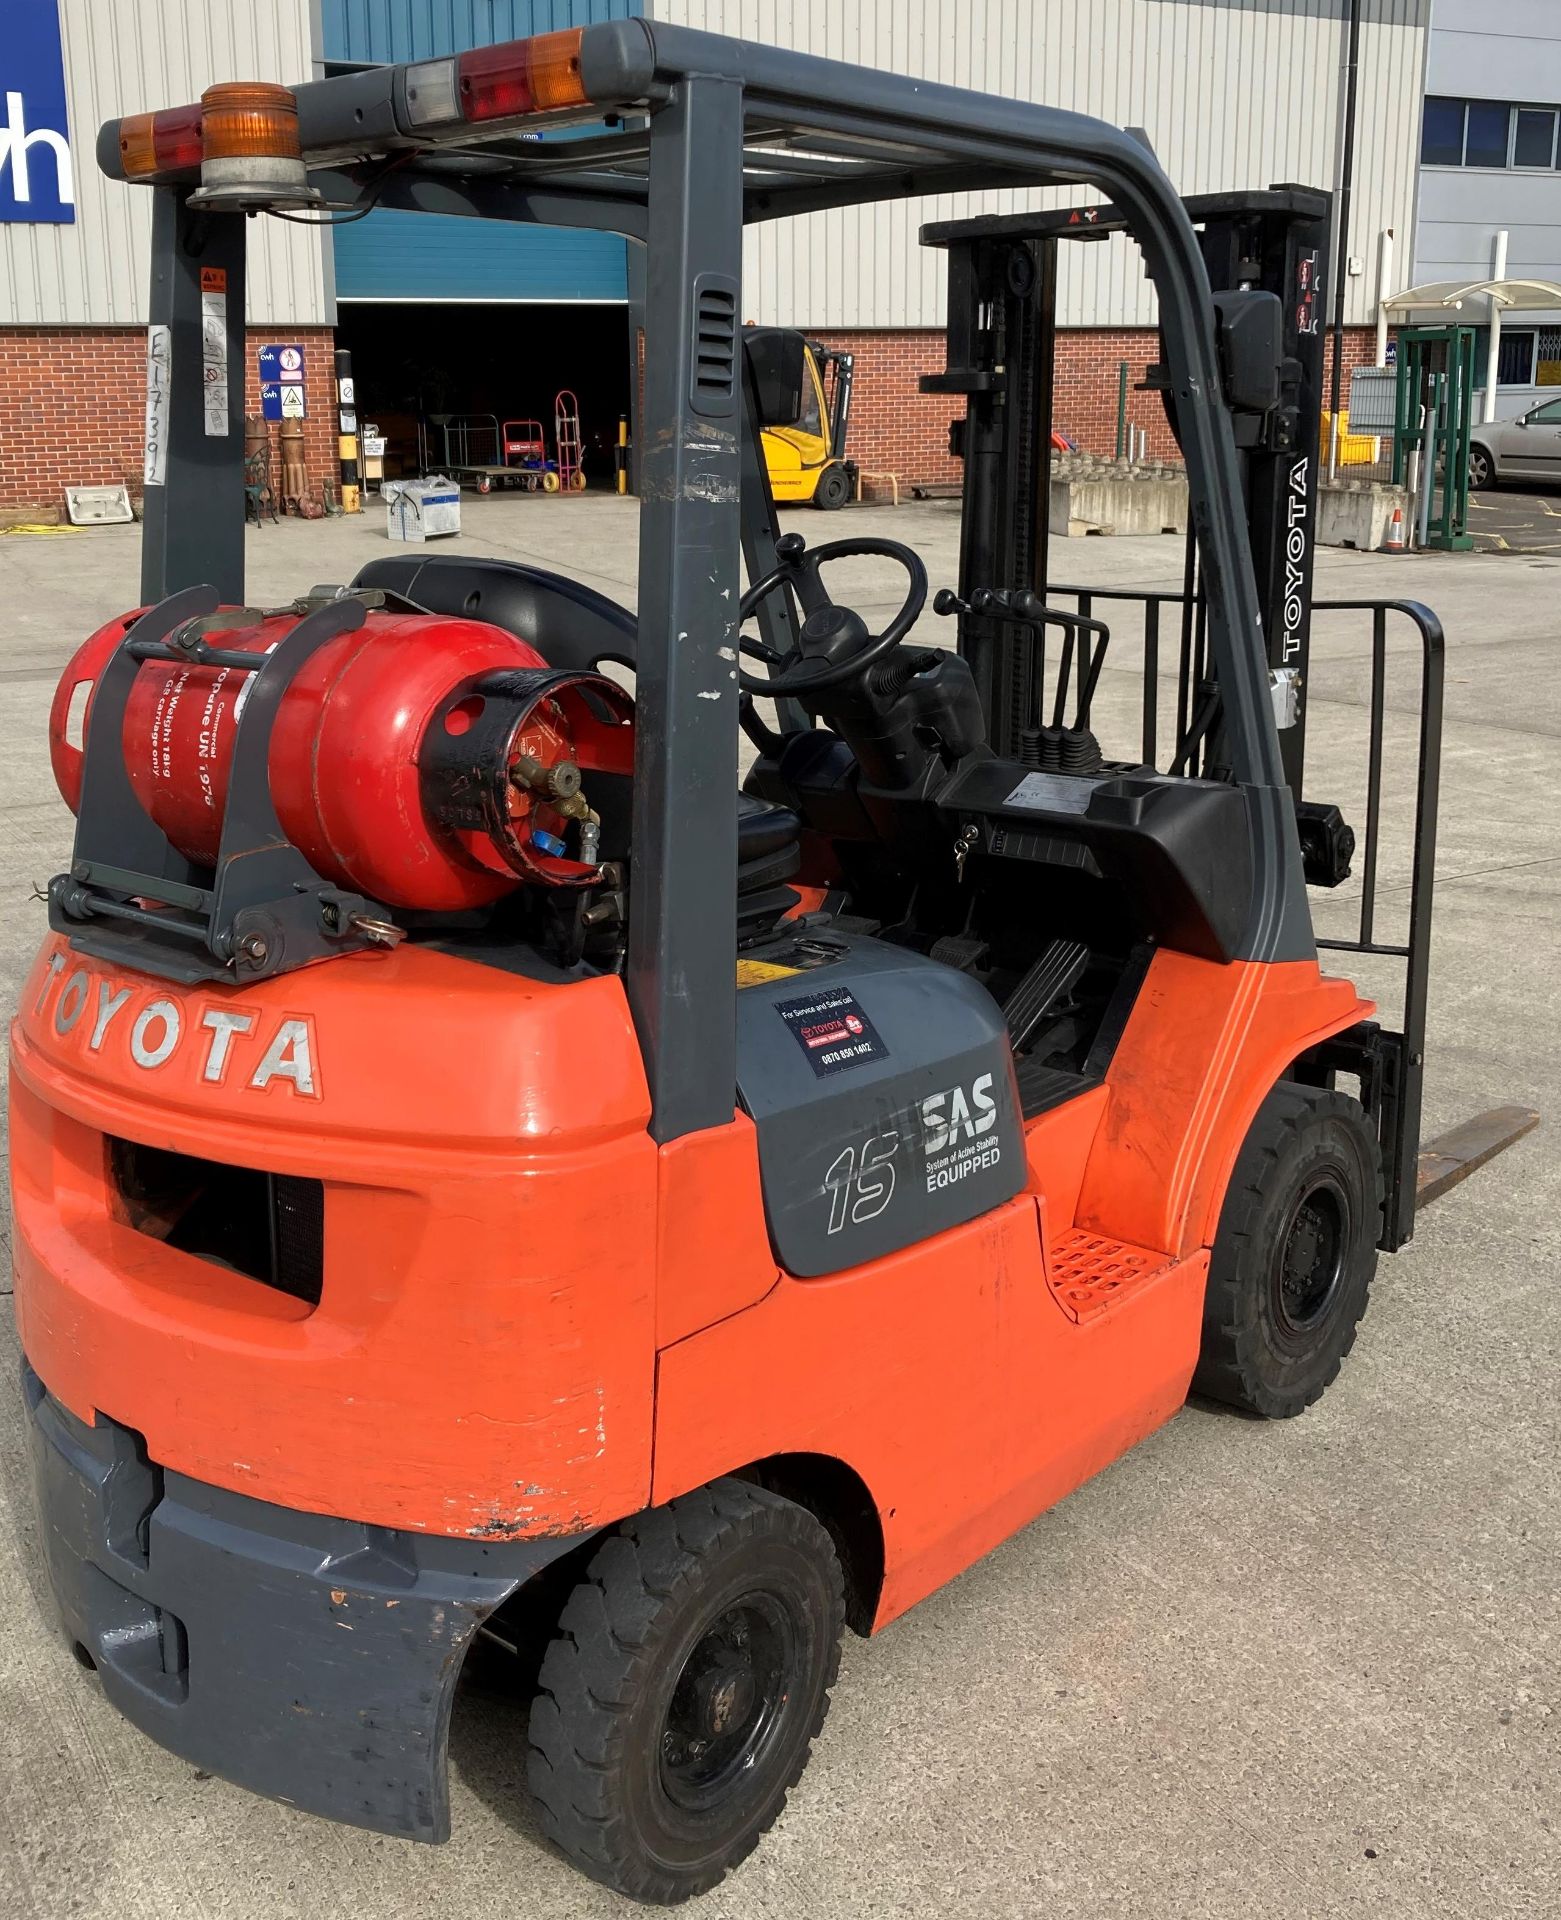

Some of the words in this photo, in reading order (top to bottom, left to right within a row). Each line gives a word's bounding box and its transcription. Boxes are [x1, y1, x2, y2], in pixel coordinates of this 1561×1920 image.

[260, 352, 275, 361] cwh
[263, 390, 277, 399] cwh
[1282, 456, 1309, 663] TOYOTA
[174, 672, 190, 694] Net
[202, 667, 231, 726] ropane
[151, 698, 166, 747] carriage
[163, 696, 180, 743] Weight
[210, 702, 224, 759] Commercial
[199, 731, 210, 758] UN
[34, 951, 319, 1097] TOYOTA
[782, 1010, 793, 1020] For
[793, 1006, 815, 1017] Service
[816, 1002, 827, 1012] and
[826, 998, 843, 1008] Sales
[813, 1019, 844, 1036] TOYOTA
[821, 1051, 840, 1065] 0870
[840, 1047, 854, 1059] 850
[854, 1042, 872, 1055] 1402
[922, 1073, 996, 1155] SAS
[926, 1157, 949, 1174] System
[950, 1151, 958, 1162] of
[957, 1145, 975, 1160] Active
[976, 1135, 999, 1153] Stability
[926, 1147, 1000, 1193] EQUIPPED
[825, 1130, 899, 1235] 15
